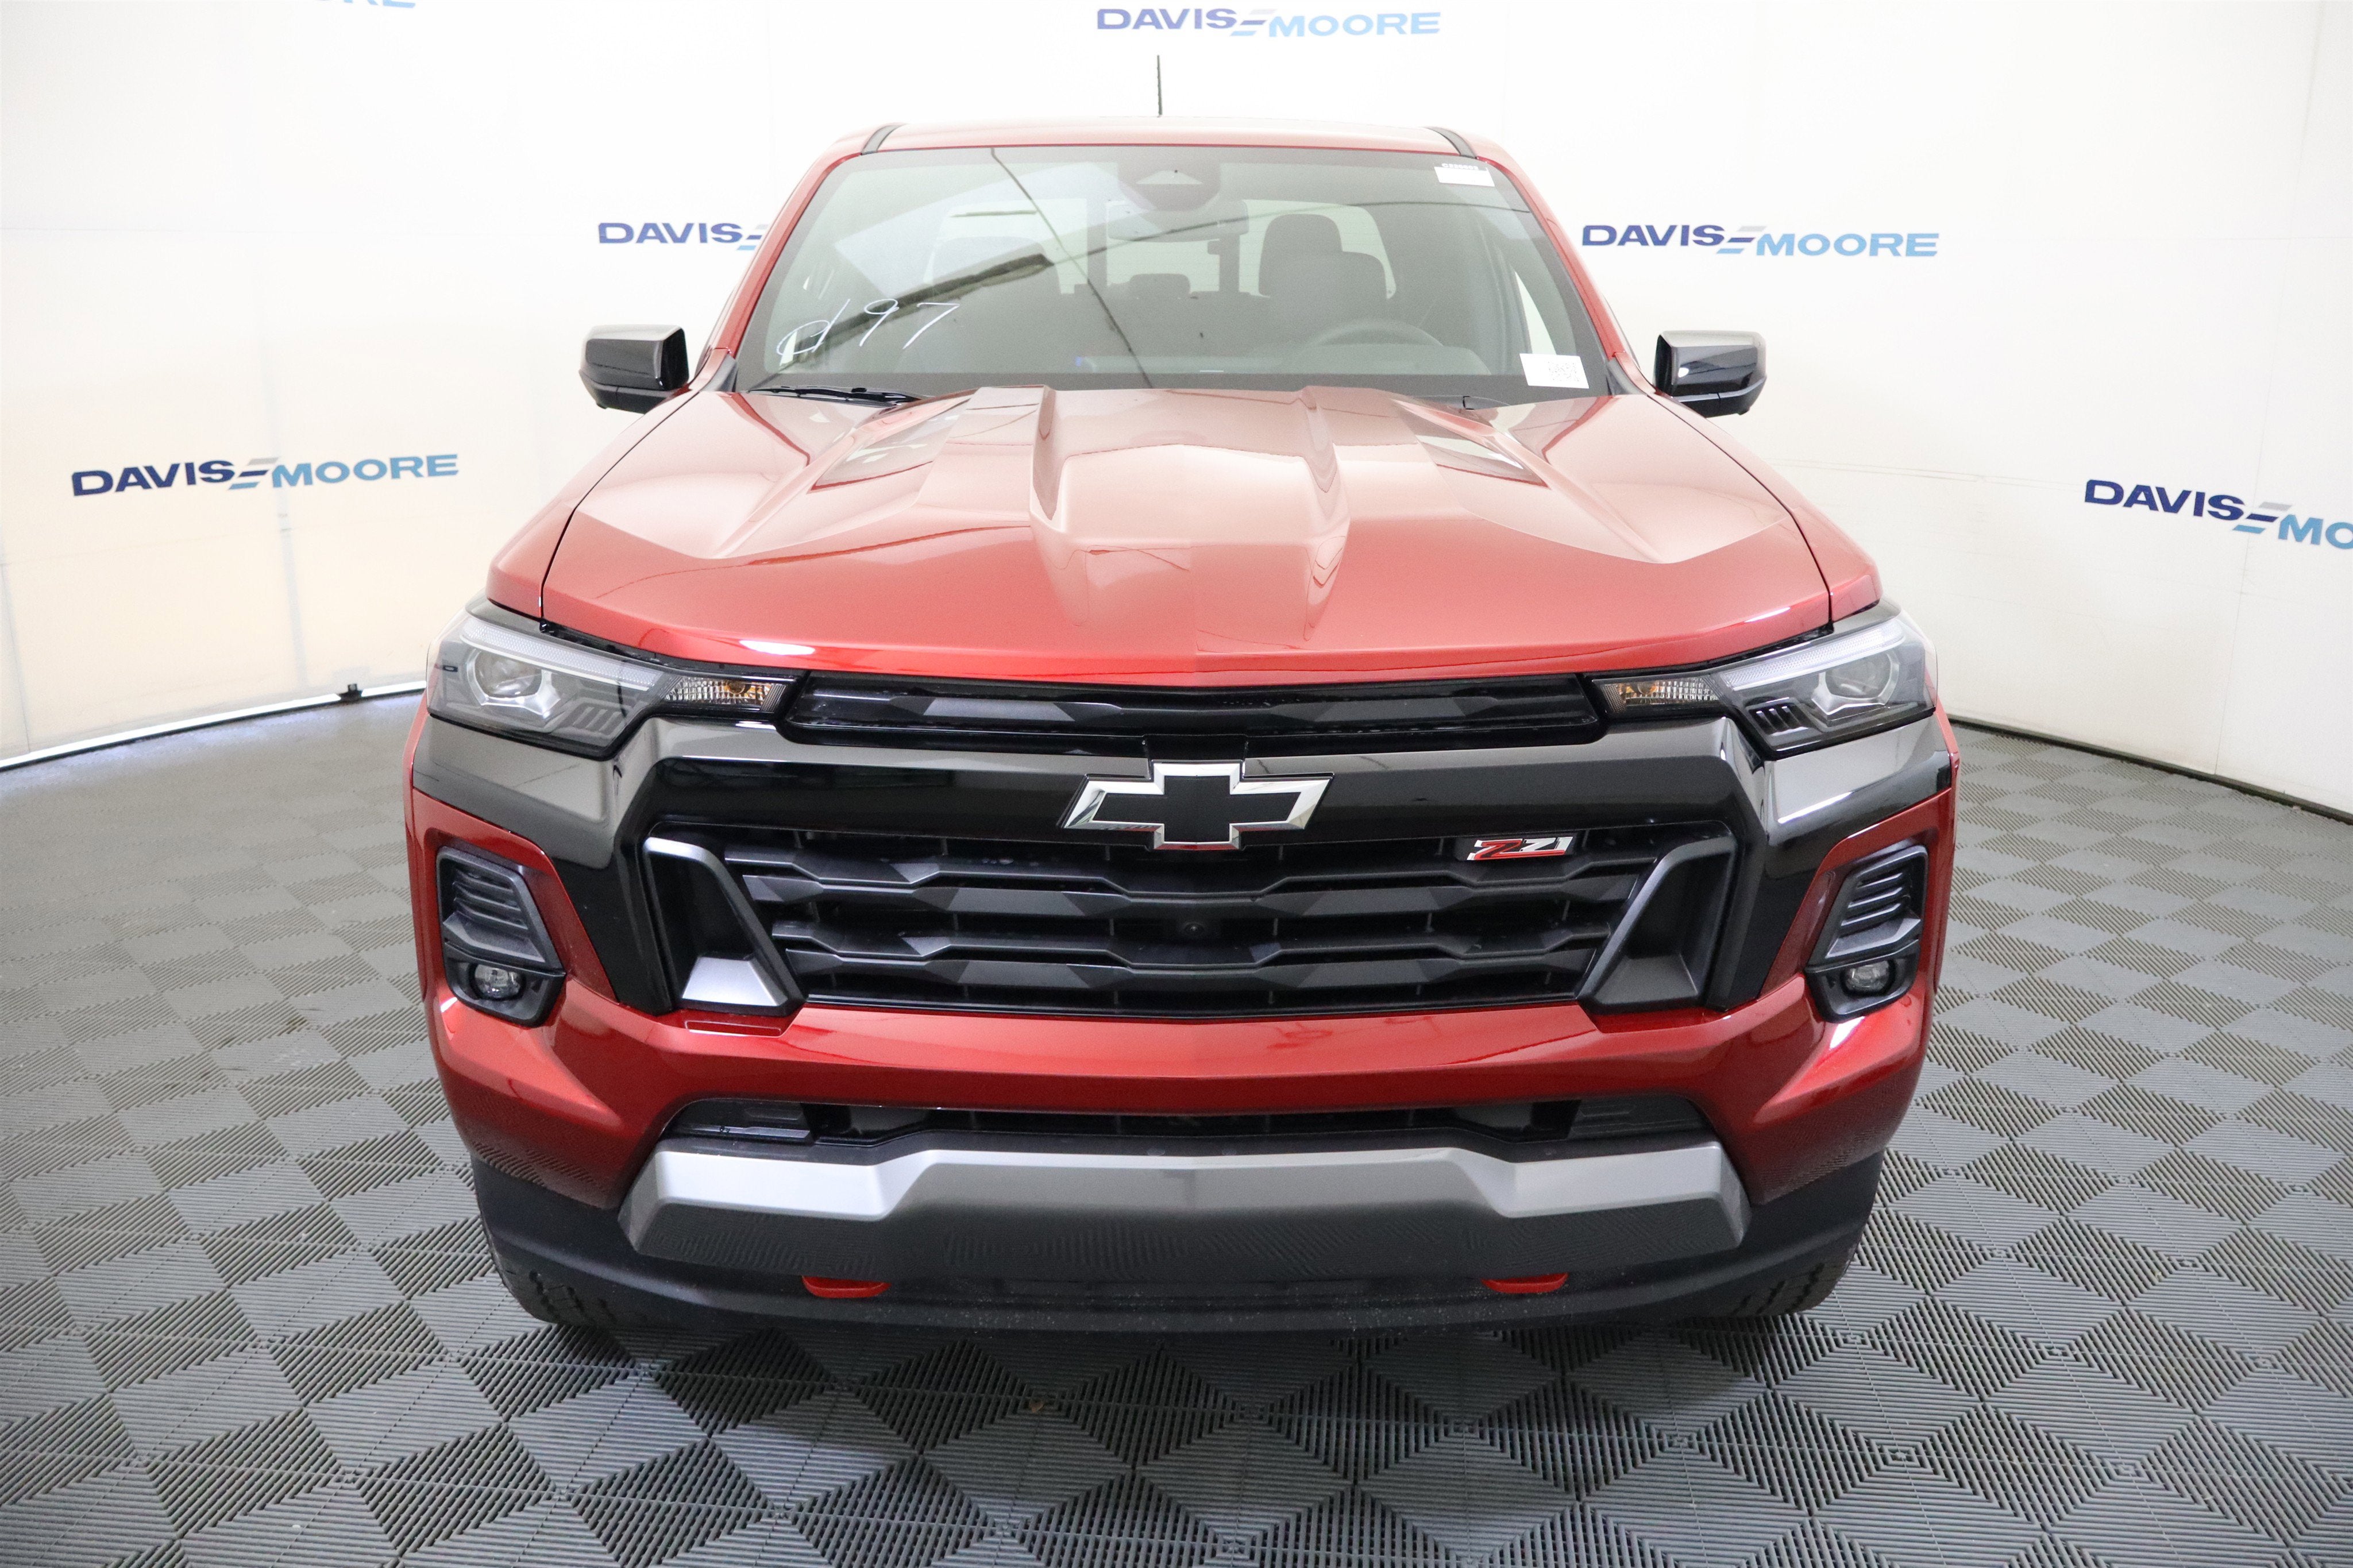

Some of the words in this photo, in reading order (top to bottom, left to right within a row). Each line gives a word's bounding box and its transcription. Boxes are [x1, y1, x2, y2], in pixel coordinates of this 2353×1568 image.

[1098, 9, 1237, 30] DAVIS
[1269, 11, 1440, 37] MOORE
[599, 222, 743, 244] DAVIS
[1582, 225, 1724, 246] DAVIS
[1756, 233, 1939, 257] MOORE
[72, 460, 235, 496] DAVIS
[273, 454, 458, 488] MOORE
[2085, 479, 2244, 521] DAVIS
